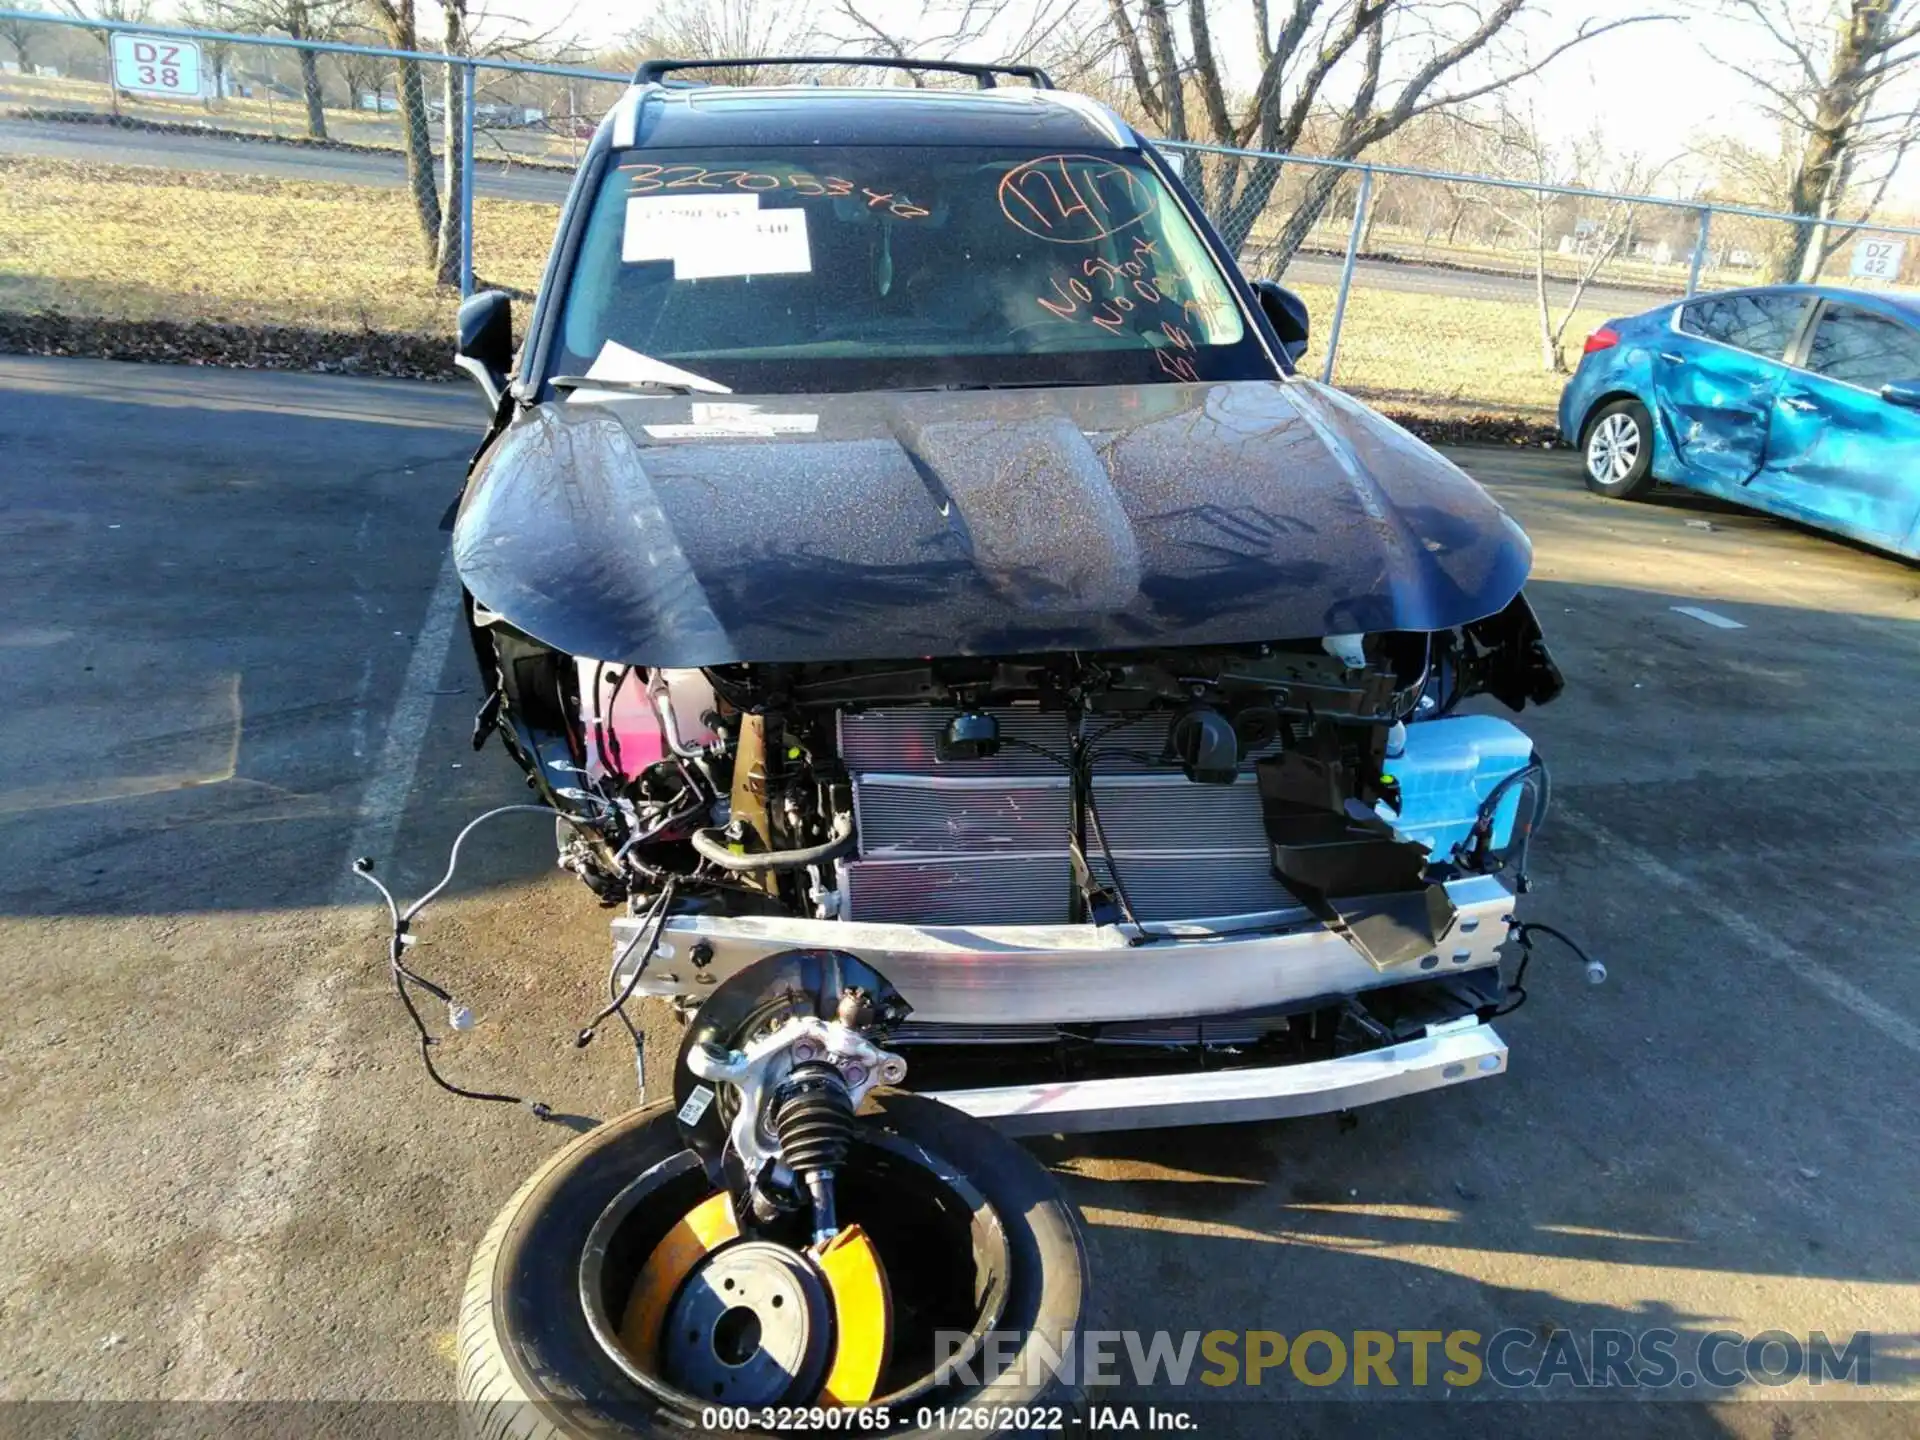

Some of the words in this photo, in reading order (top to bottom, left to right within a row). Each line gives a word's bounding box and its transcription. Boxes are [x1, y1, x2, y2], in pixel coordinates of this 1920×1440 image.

[134, 43, 180, 67] DZ
[138, 66, 179, 88] 38
[1866, 243, 1893, 260] DZ
[1864, 260, 1887, 274] 42
